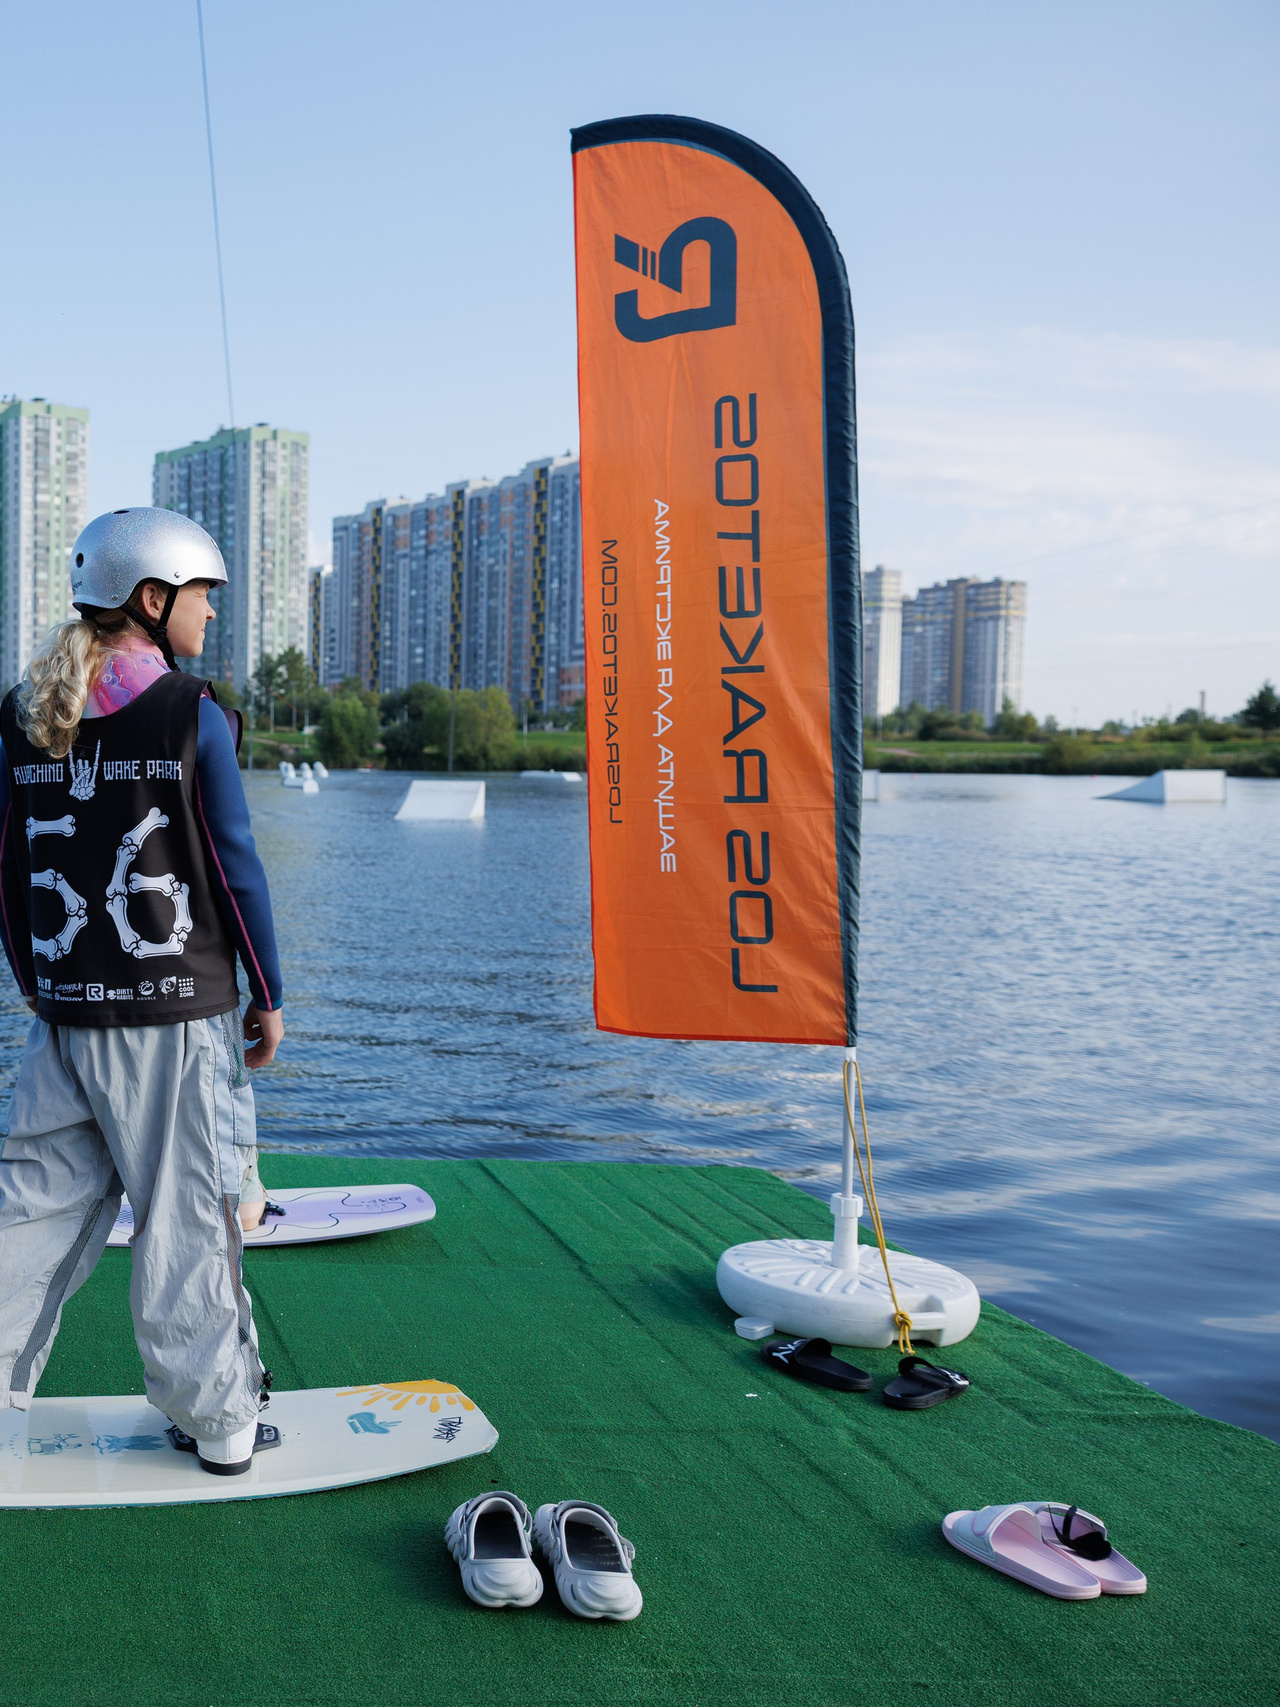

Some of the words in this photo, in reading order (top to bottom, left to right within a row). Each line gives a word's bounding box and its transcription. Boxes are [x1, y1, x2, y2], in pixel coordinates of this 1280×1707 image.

[103, 760, 140, 781] WAKE
[146, 759, 183, 781] PARK
[25, 807, 193, 961] 56
